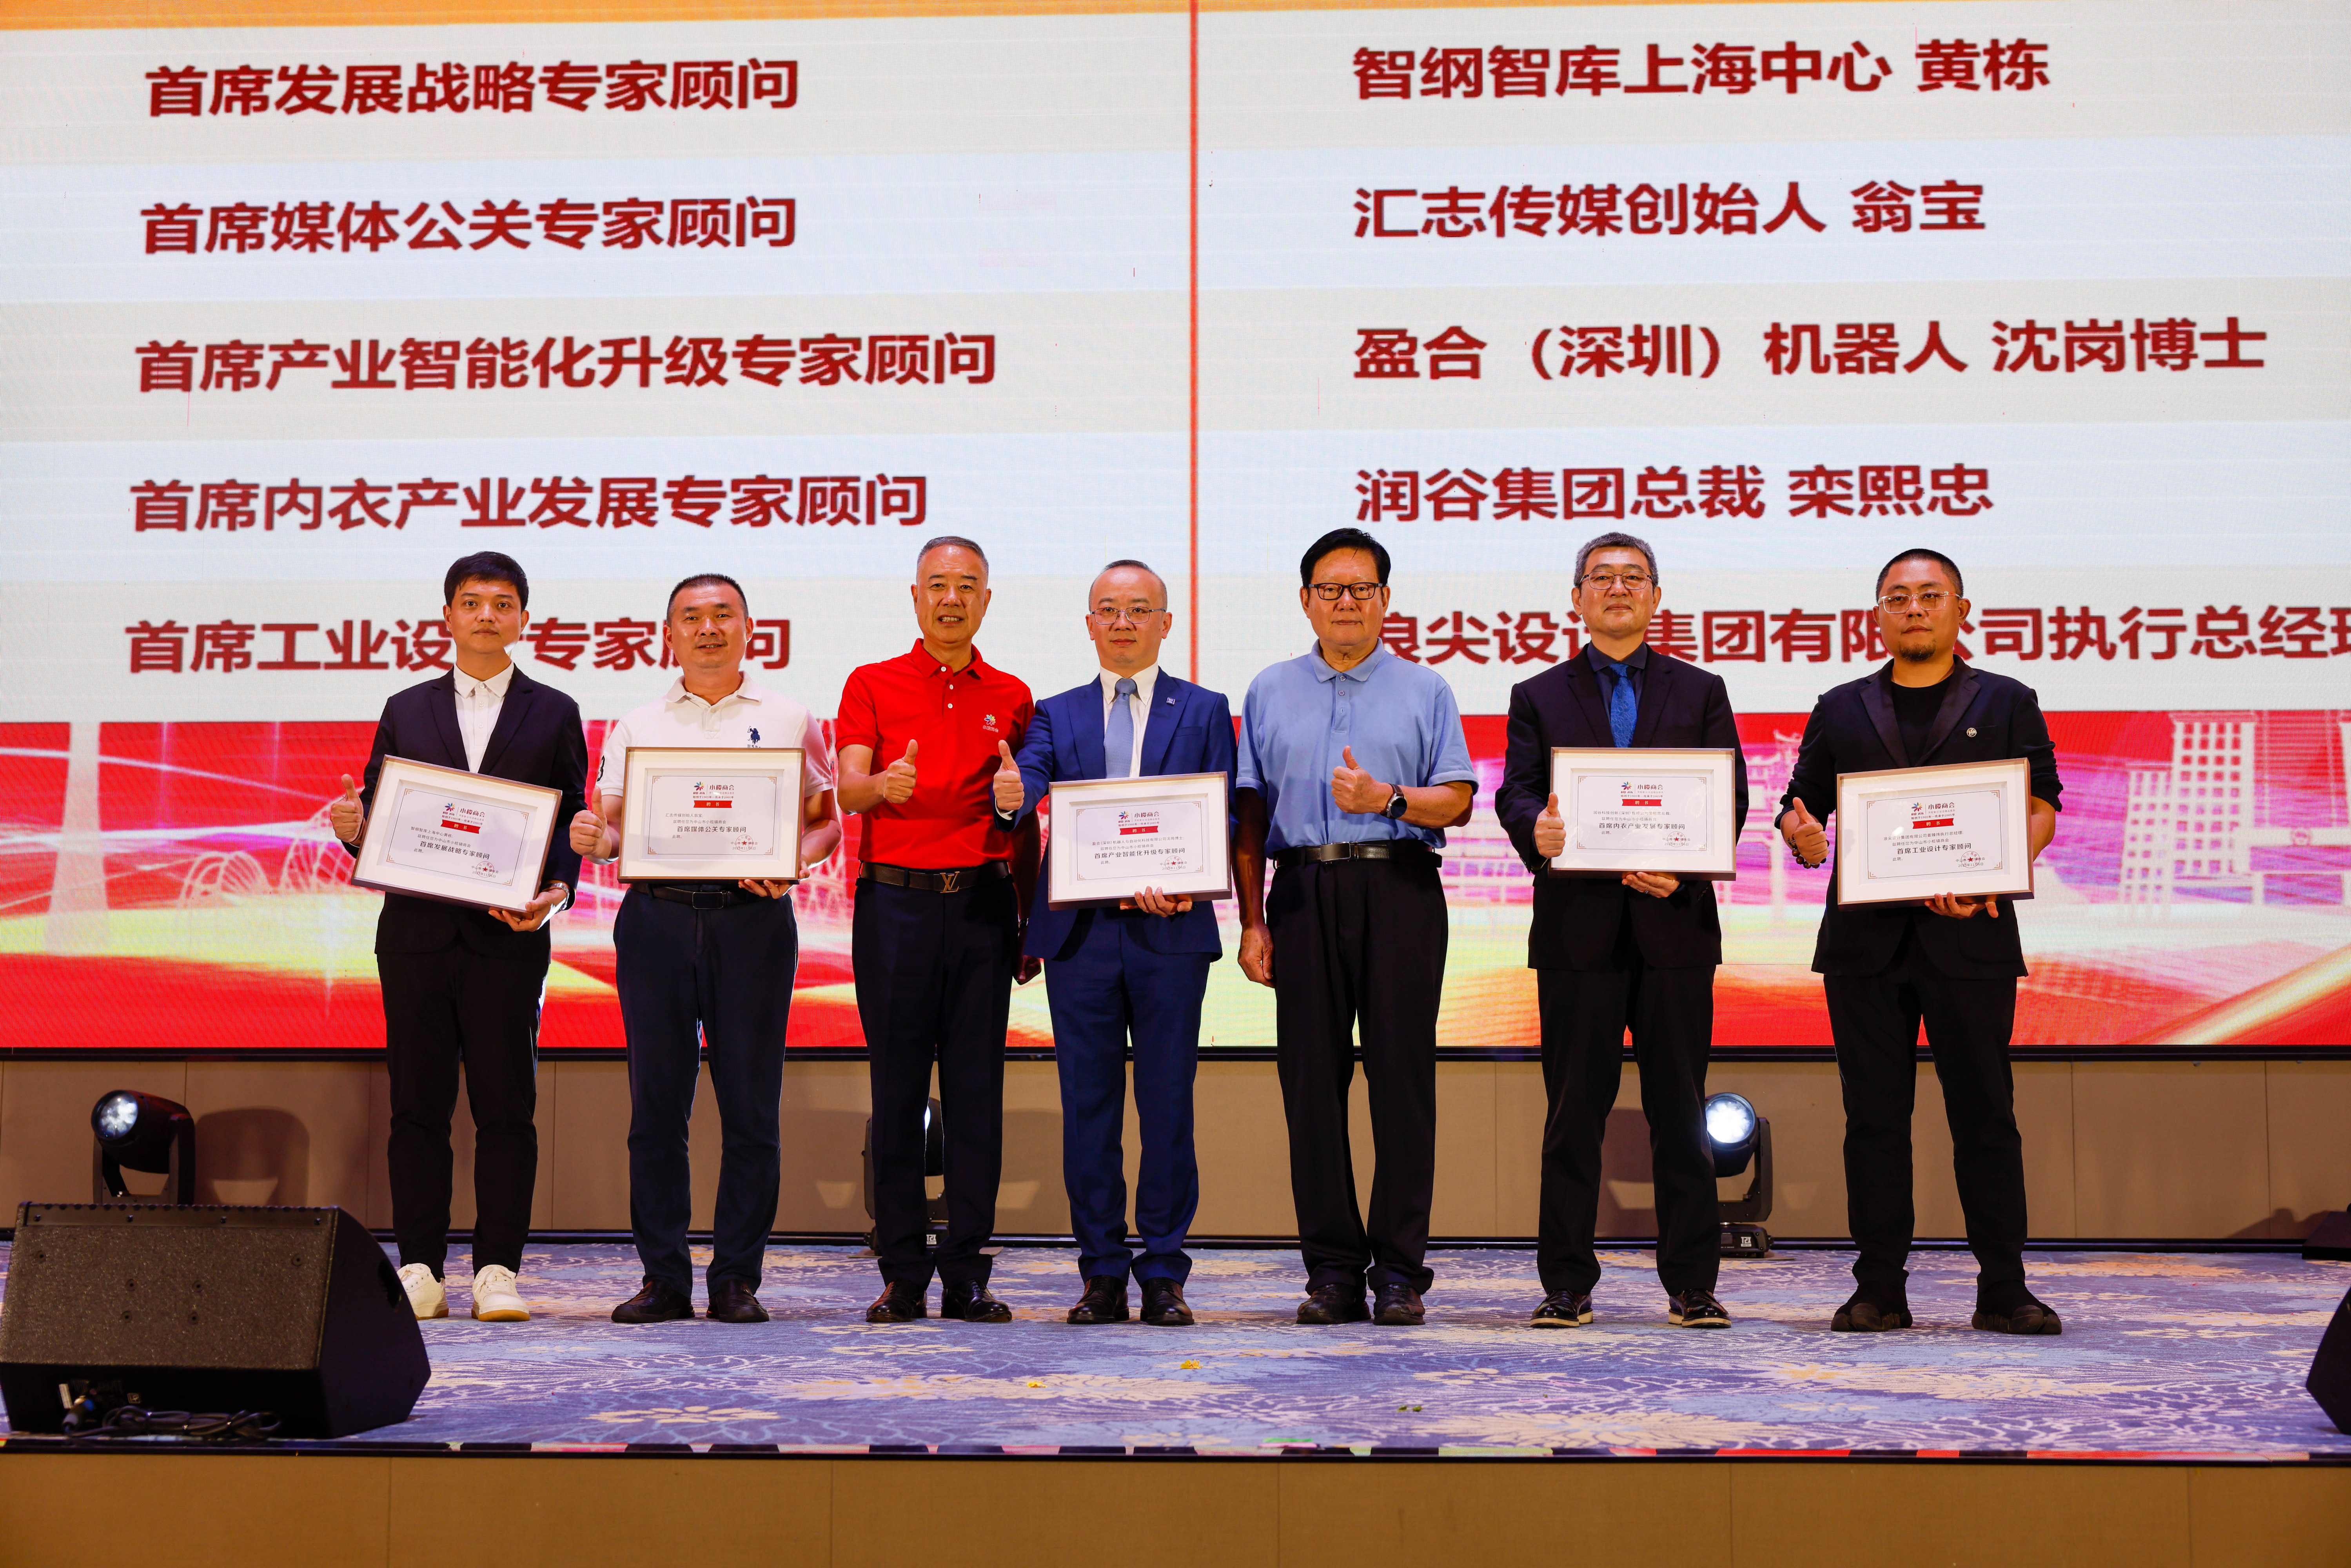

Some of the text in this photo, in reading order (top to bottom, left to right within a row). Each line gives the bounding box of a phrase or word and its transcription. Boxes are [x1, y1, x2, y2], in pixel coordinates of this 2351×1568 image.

[145, 58, 797, 117] 首席发展战略专家顾问
[1354, 38, 2049, 100] 智纲智库上海中心 黄栋
[141, 196, 795, 254] 首席媒体公关专家顾问
[1355, 180, 1984, 237] 汇志传媒创始人 翁宝
[136, 333, 995, 392] 首席产业智能化升级专家顾问
[1993, 317, 2266, 372] 沈岗博士
[131, 474, 926, 531] 首席内衣产业发展专家顾问
[1357, 465, 1992, 521] 润谷集团总裁 栾熙忠
[125, 618, 790, 673] 首席工业设专家问
[460, 808, 485, 817] 小榄商会
[420, 841, 490, 859] 首席发展战略专家顾问
[1094, 848, 1185, 859] 首席产业智能化升级专家顾问
[1897, 843, 1971, 855] 首席工业设计专家顾问
